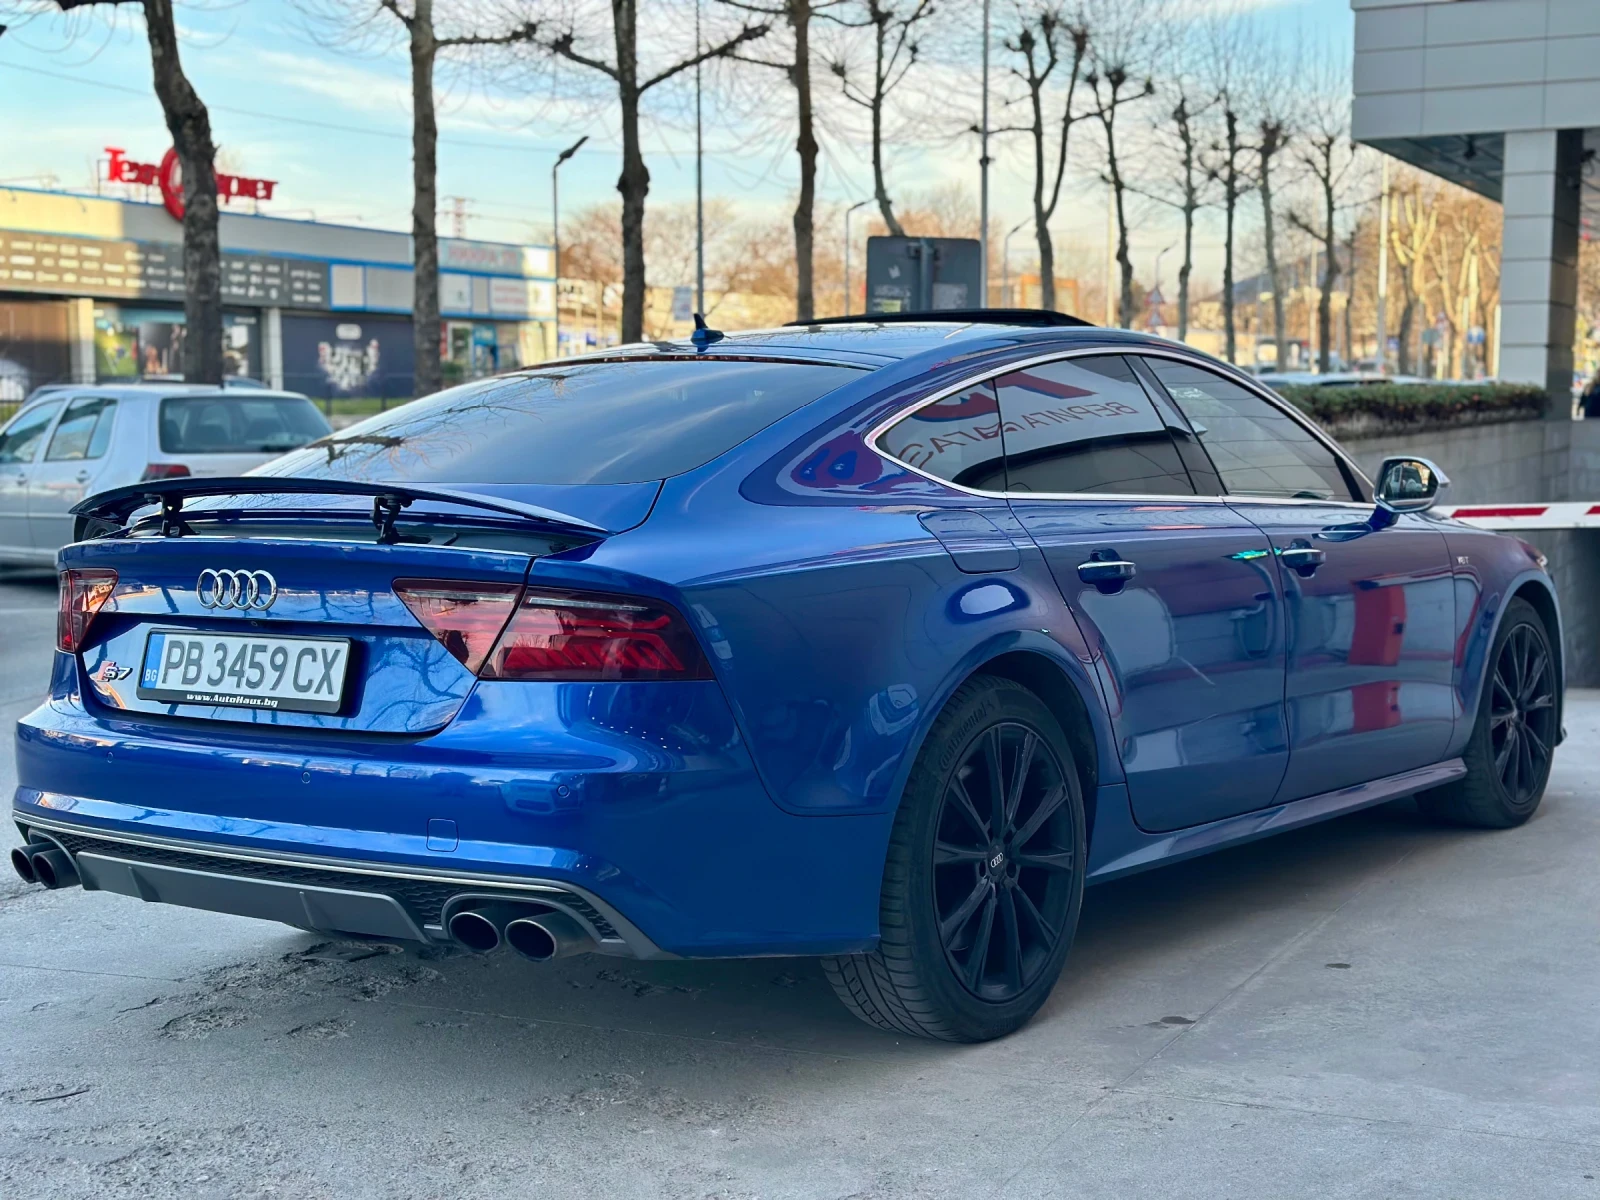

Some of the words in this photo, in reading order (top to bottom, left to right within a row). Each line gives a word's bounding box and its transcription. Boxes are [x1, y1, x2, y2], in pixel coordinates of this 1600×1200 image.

[100, 663, 133, 681] S7
[144, 669, 157, 682] BG
[162, 640, 204, 686] PB
[207, 642, 288, 691] 3459
[292, 647, 341, 695] CX
